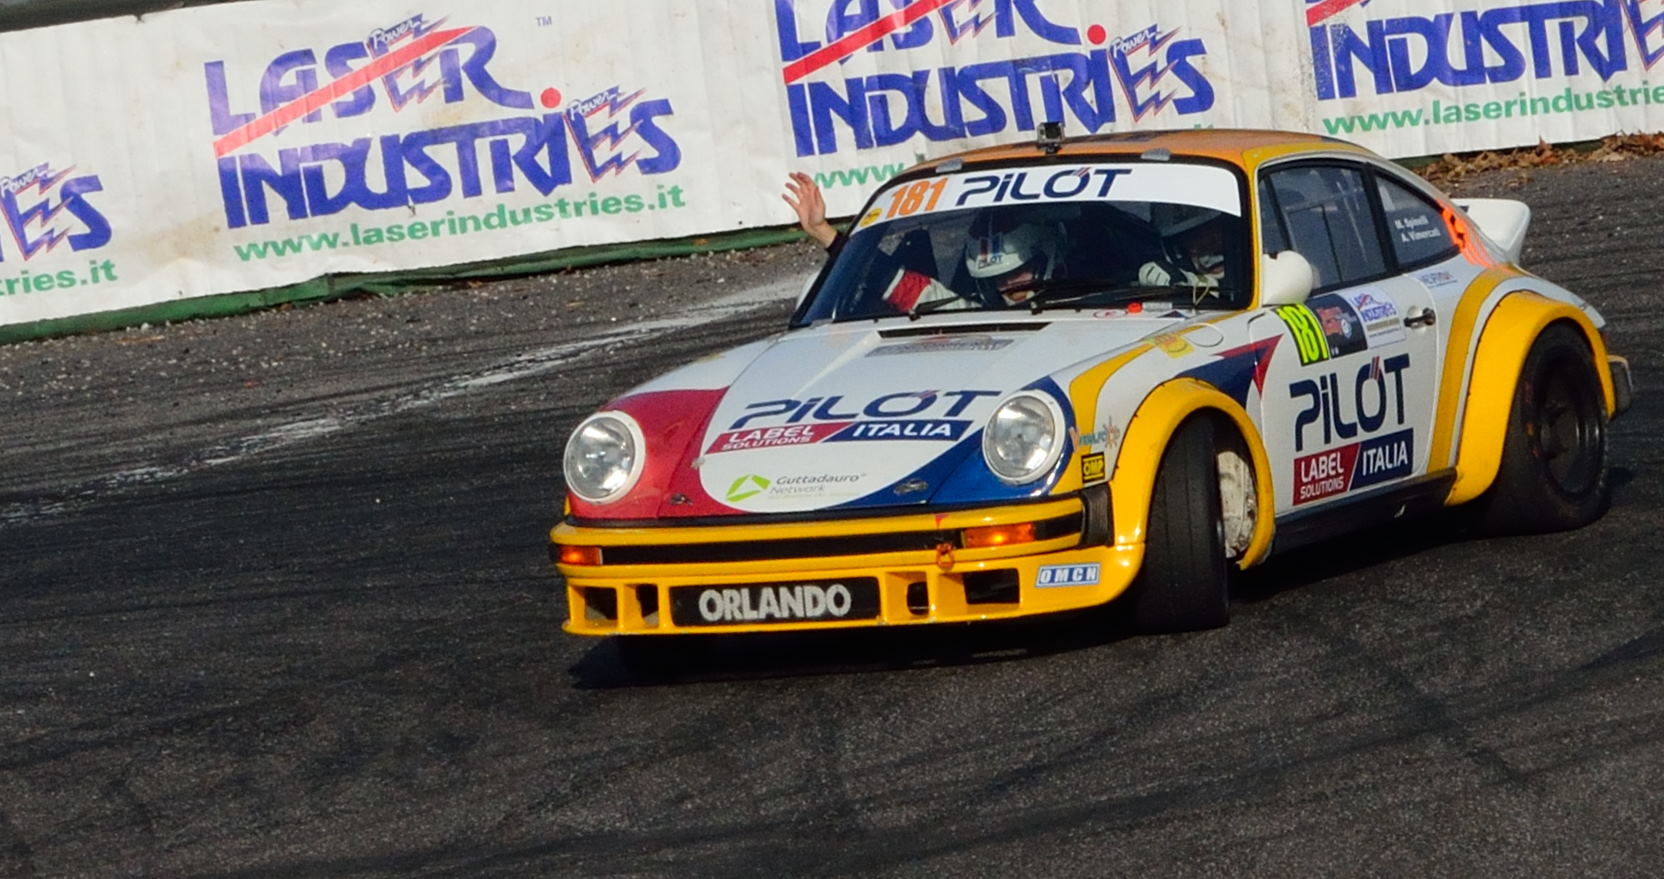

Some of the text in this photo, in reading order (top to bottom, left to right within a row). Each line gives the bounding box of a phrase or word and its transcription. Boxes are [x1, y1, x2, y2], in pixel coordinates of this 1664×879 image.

[536, 16, 553, 27] TM
[204, 14, 533, 137] LASER
[886, 177, 949, 219] 181
[234, 185, 685, 261] www.laserindustries.it
[0, 260, 118, 296] ries.it
[1275, 303, 1328, 364] 181
[722, 436, 811, 450] SOLUTIONS
[729, 425, 815, 442] LABEL
[852, 422, 951, 437] ITALIA
[1083, 460, 1104, 475] OMP
[1301, 452, 1344, 482] LABEL
[1362, 441, 1408, 476] ITALIA
[769, 485, 825, 495] Network
[1300, 476, 1344, 499] SOLUTIONS
[699, 584, 851, 622] ORLANDO
